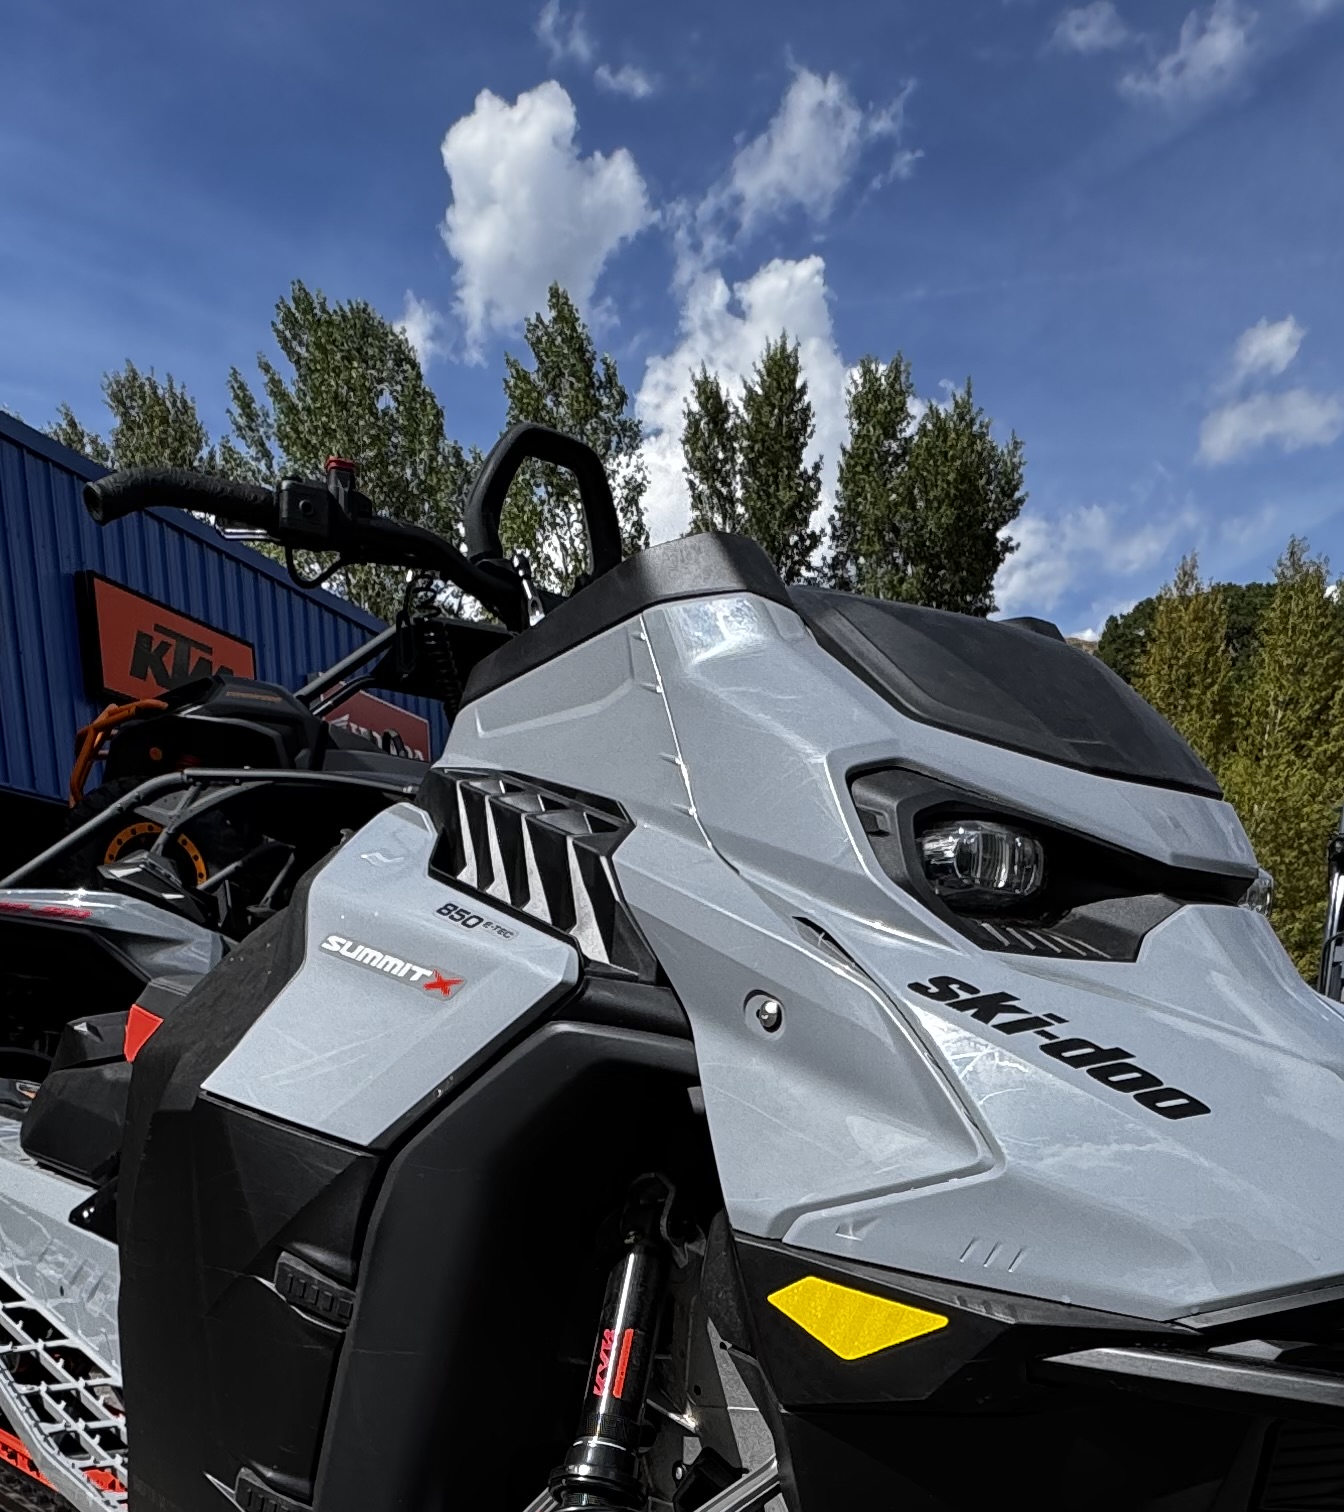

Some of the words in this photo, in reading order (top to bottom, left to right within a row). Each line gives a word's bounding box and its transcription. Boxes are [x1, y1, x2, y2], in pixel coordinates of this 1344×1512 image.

[436, 903, 484, 929] 850
[321, 934, 433, 982] SUMMIT
[908, 975, 1212, 1121] ski-doo
